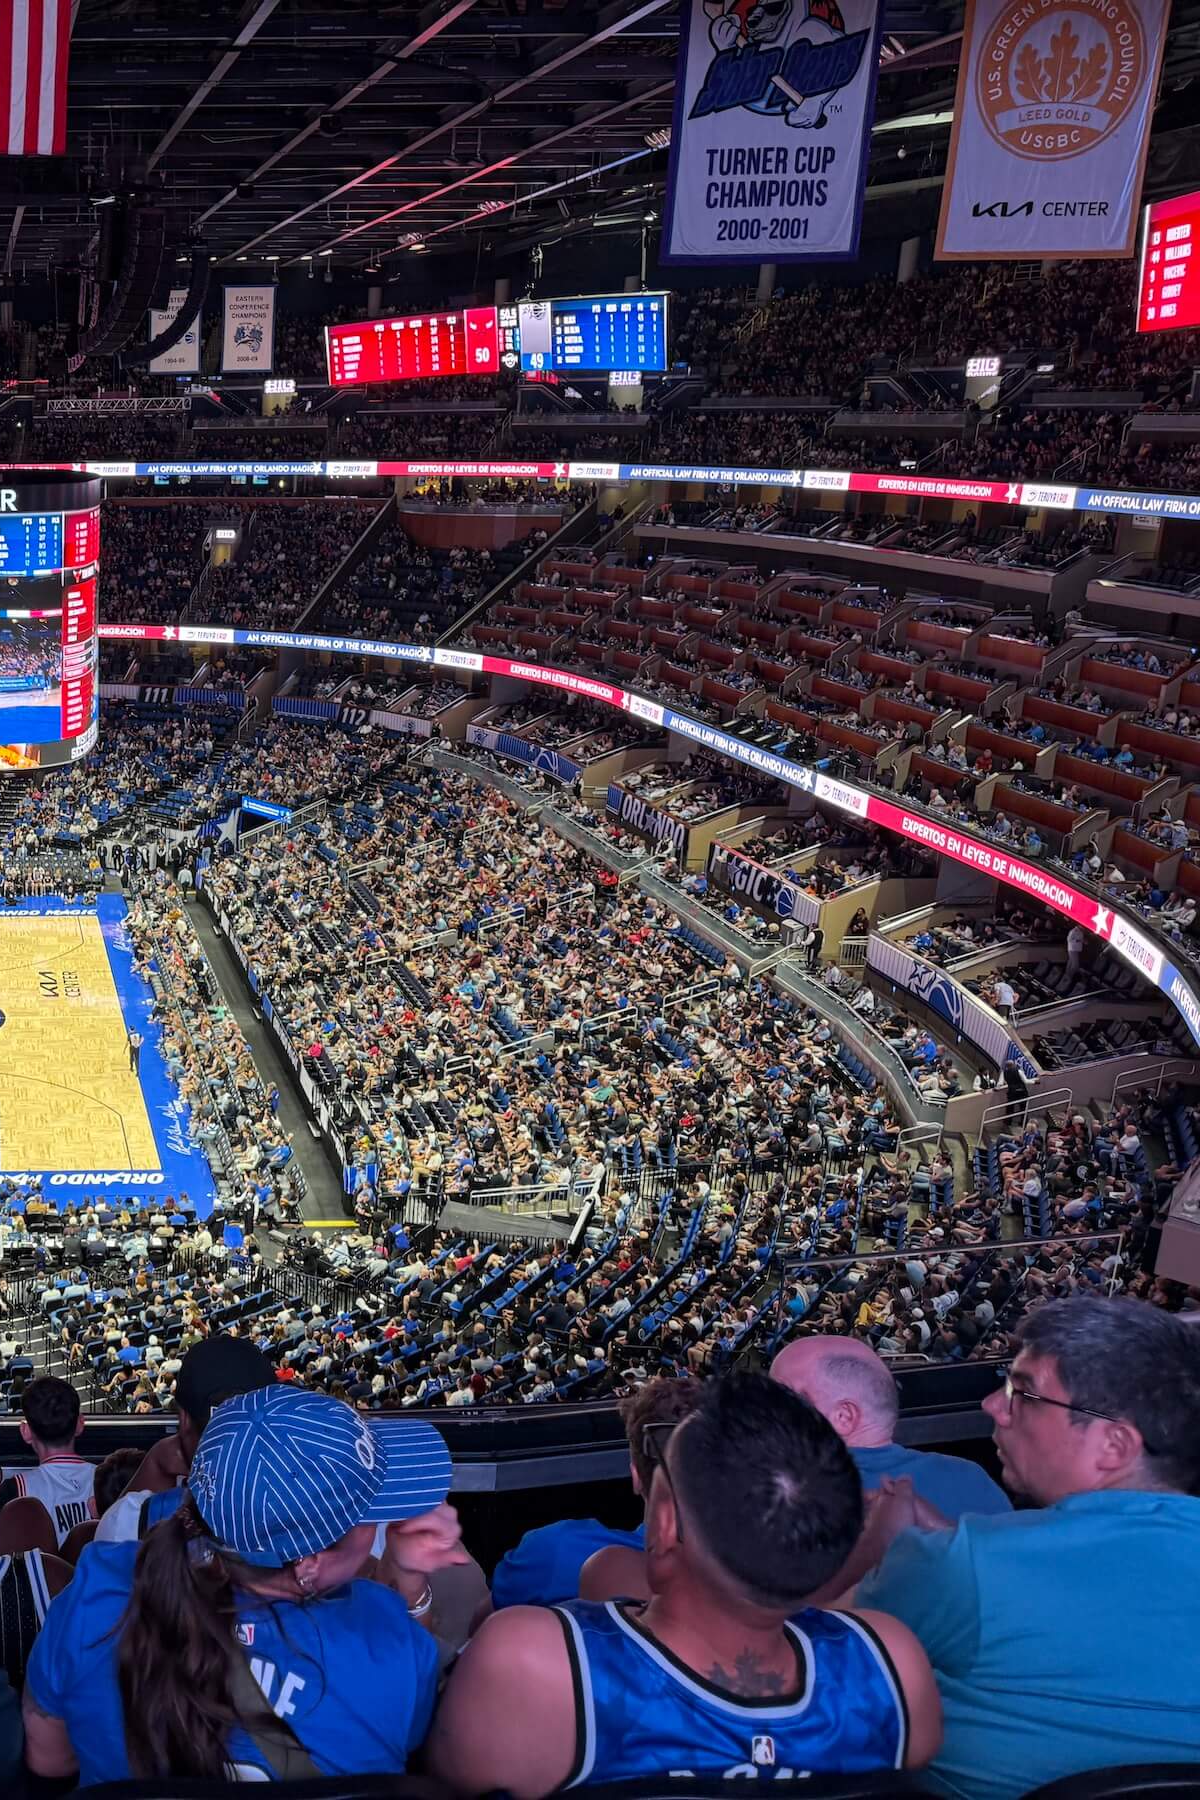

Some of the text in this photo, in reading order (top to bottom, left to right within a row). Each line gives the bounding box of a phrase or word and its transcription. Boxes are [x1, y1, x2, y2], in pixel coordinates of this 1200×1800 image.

[991, 4, 1036, 61] GREEN
[1108, 21, 1135, 102] COUNCIL
[829, 105, 843, 113] TM
[1018, 109, 1091, 123] LEED GOLD
[1019, 130, 1081, 149] USGBC
[706, 146, 836, 176] TURNER CUP
[705, 179, 828, 209] CHAMPIONS
[971, 201, 1109, 217] KIA CENTER
[716, 217, 809, 241] 2000-2001
[475, 347, 490, 364] 50
[529, 352, 544, 369] 49
[966, 357, 1000, 371] BIG
[264, 380, 296, 390] BIG
[609, 371, 642, 382] BIG
[1087, 495, 1102, 506] AN
[1102, 495, 1141, 510] OFFICIAL
[1141, 498, 1163, 512] LAW
[1161, 499, 1188, 514] FIRM
[246, 633, 260, 642] AN
[260, 634, 295, 645] OFFICIAL
[295, 637, 313, 646] LAW
[313, 638, 332, 649] FIRM
[332, 639, 344, 649] OF
[344, 641, 360, 651] THE
[360, 642, 397, 655] ORLANDO
[143, 687, 168, 703] 111
[341, 708, 366, 726] 112
[902, 816, 1073, 910] EXPERTOS EN LEYES DE INMIGRACION
[44, 908, 98, 917] MAGIC
[49, 1172, 165, 1185] ORLANDO
[54, 1500, 89, 1533] AVDI
